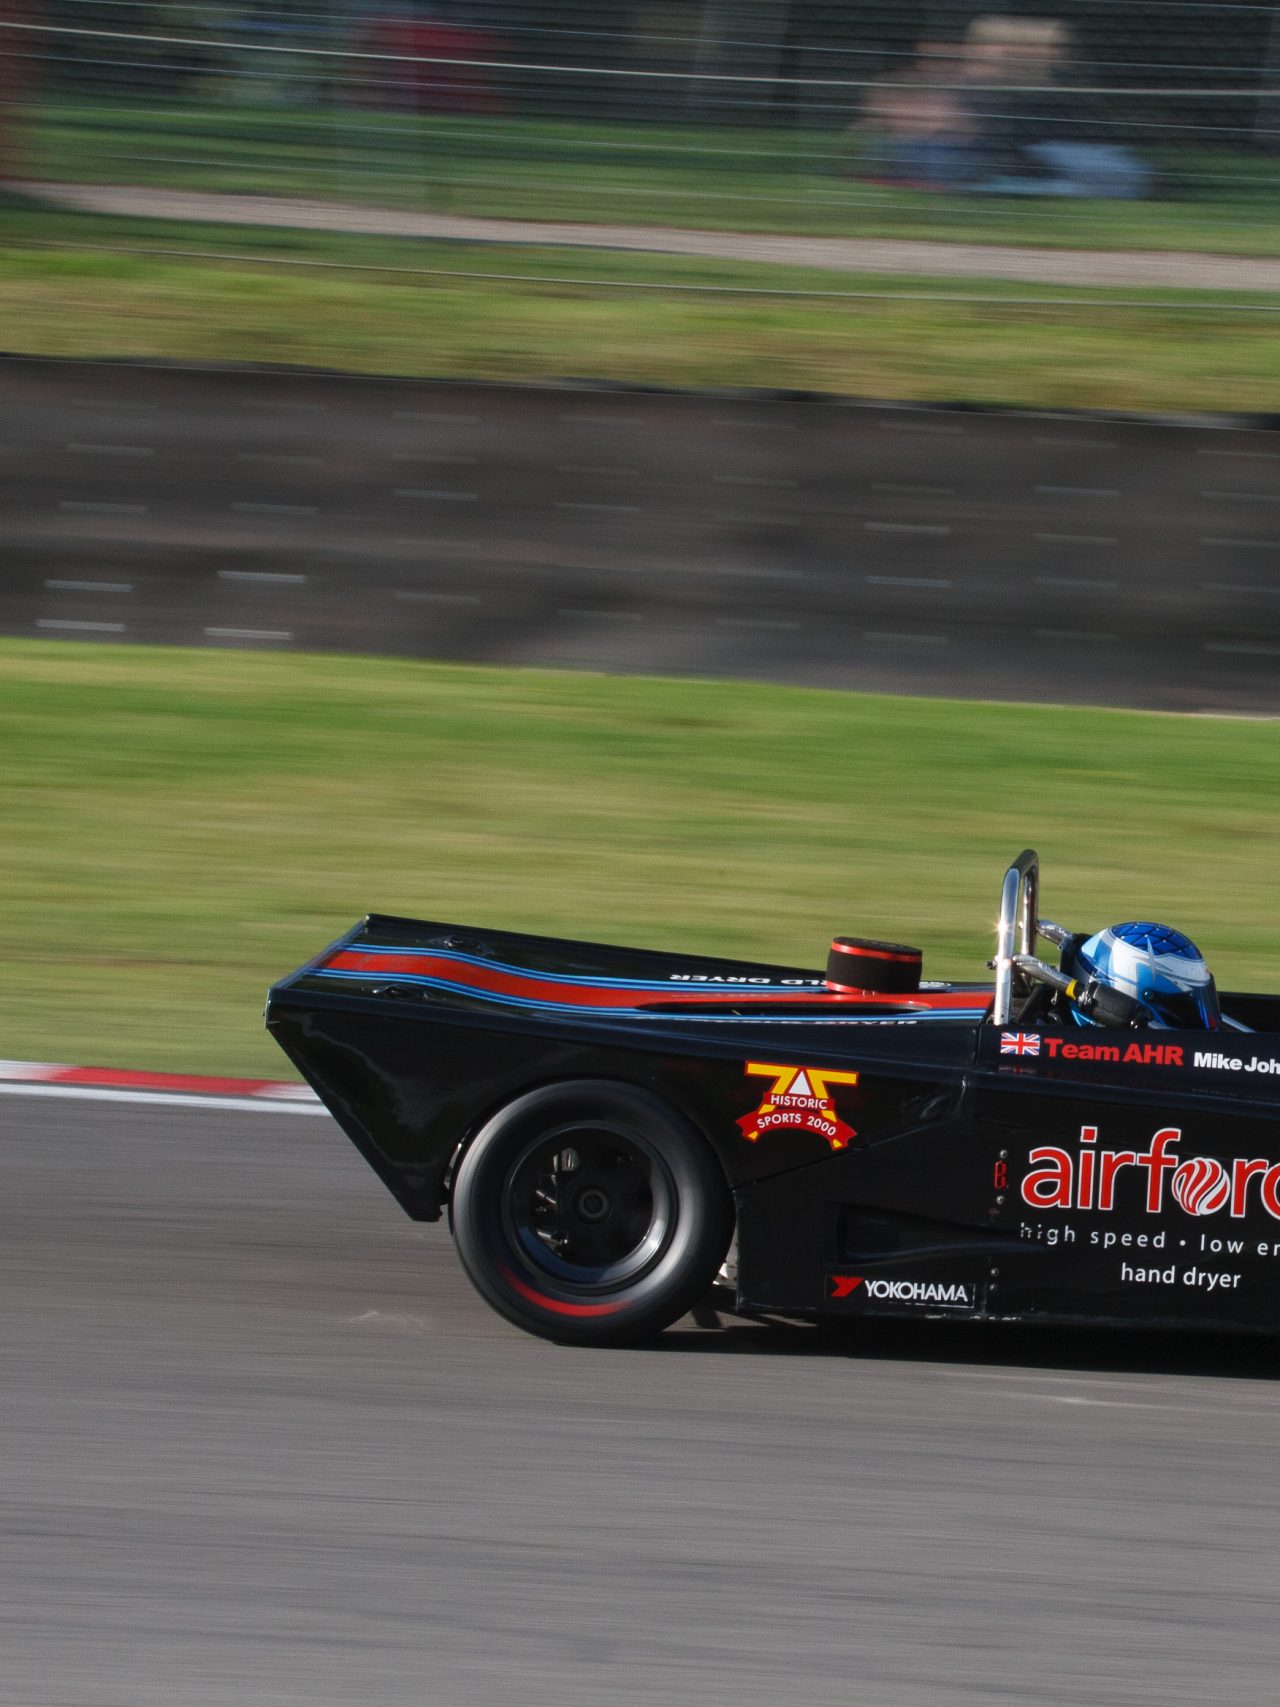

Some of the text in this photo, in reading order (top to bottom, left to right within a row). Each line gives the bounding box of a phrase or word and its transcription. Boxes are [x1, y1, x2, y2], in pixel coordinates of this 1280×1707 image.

[1044, 1038, 1119, 1062] Team
[1122, 1043, 1184, 1066] AHR
[1193, 1051, 1243, 1071] Mike
[770, 1094, 828, 1111] HISTORIC
[757, 1113, 837, 1136] SPORTS 2000
[1020, 1222, 1076, 1245] high
[1090, 1231, 1166, 1249] speed
[1200, 1234, 1244, 1254] low
[1120, 1263, 1242, 1292] hand dryer
[864, 1280, 968, 1302] YOKOHAMA
